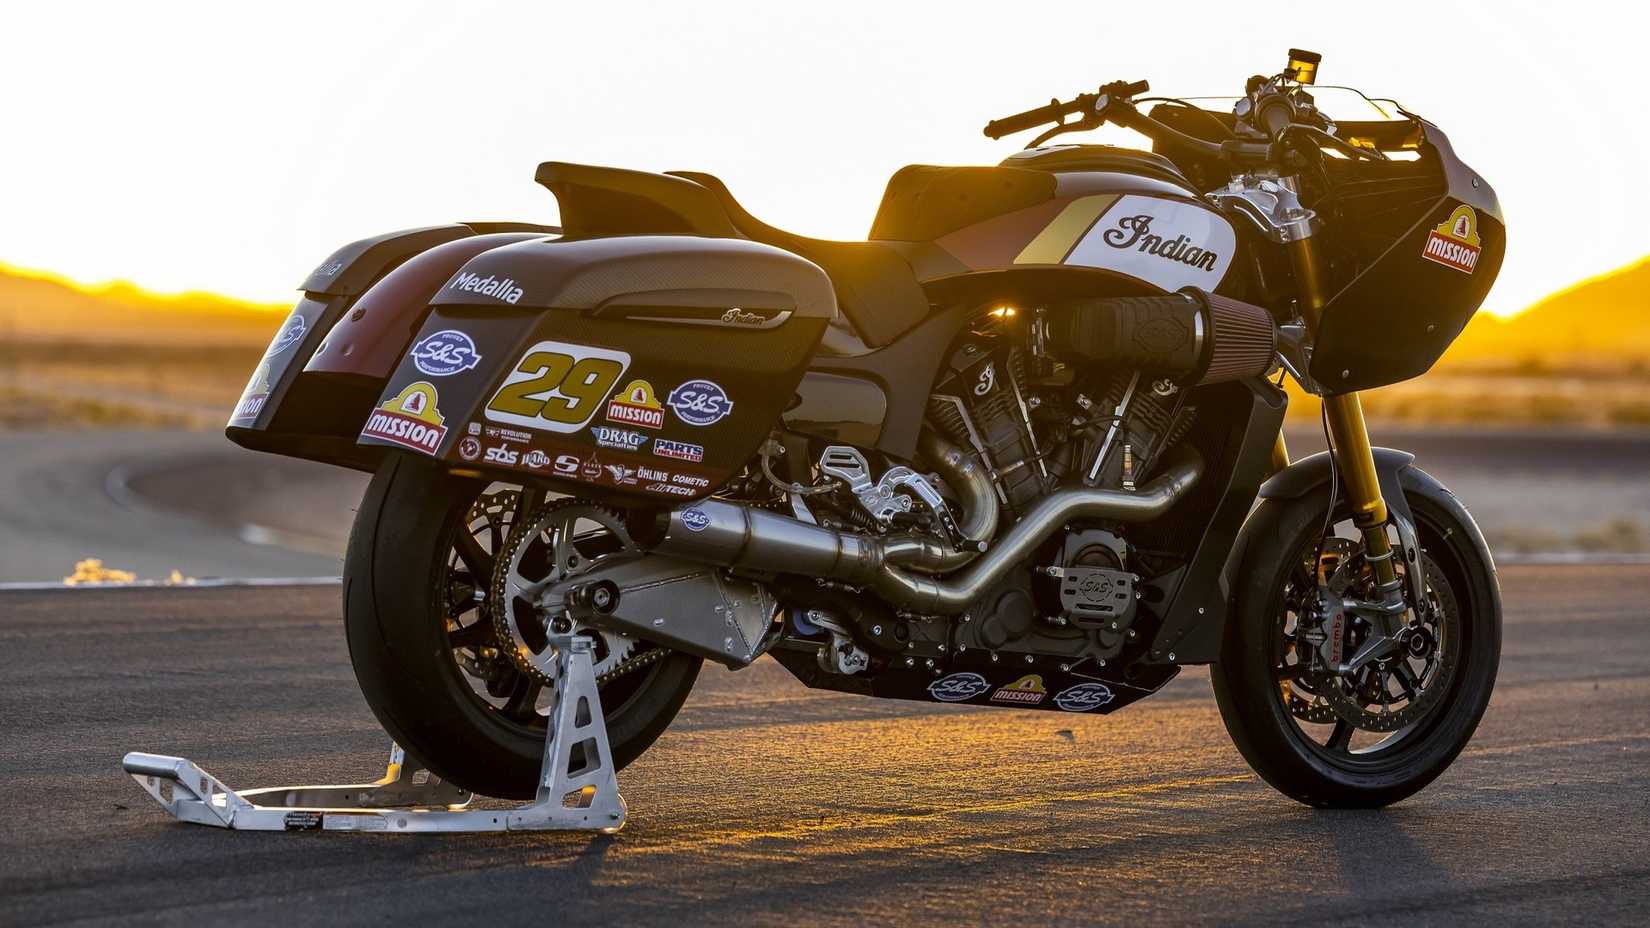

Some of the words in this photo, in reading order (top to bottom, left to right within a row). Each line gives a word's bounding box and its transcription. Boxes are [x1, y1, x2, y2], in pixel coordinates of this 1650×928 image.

[1103, 214, 1218, 272] Indian
[1427, 237, 1477, 268] MISSION
[450, 272, 524, 304] Medallia
[418, 341, 471, 364] S&S
[487, 351, 624, 424] 29
[676, 391, 724, 413] S&S
[609, 404, 661, 425] MISSION
[367, 414, 439, 448] MISSION
[600, 427, 640, 445] DRAG
[655, 440, 703, 455] PARTS
[637, 466, 668, 482] ÖHLINS
[672, 475, 709, 487] COMETIC
[684, 512, 707, 525] S&S
[935, 680, 983, 693] S&S
[1058, 690, 1107, 703] S&S
